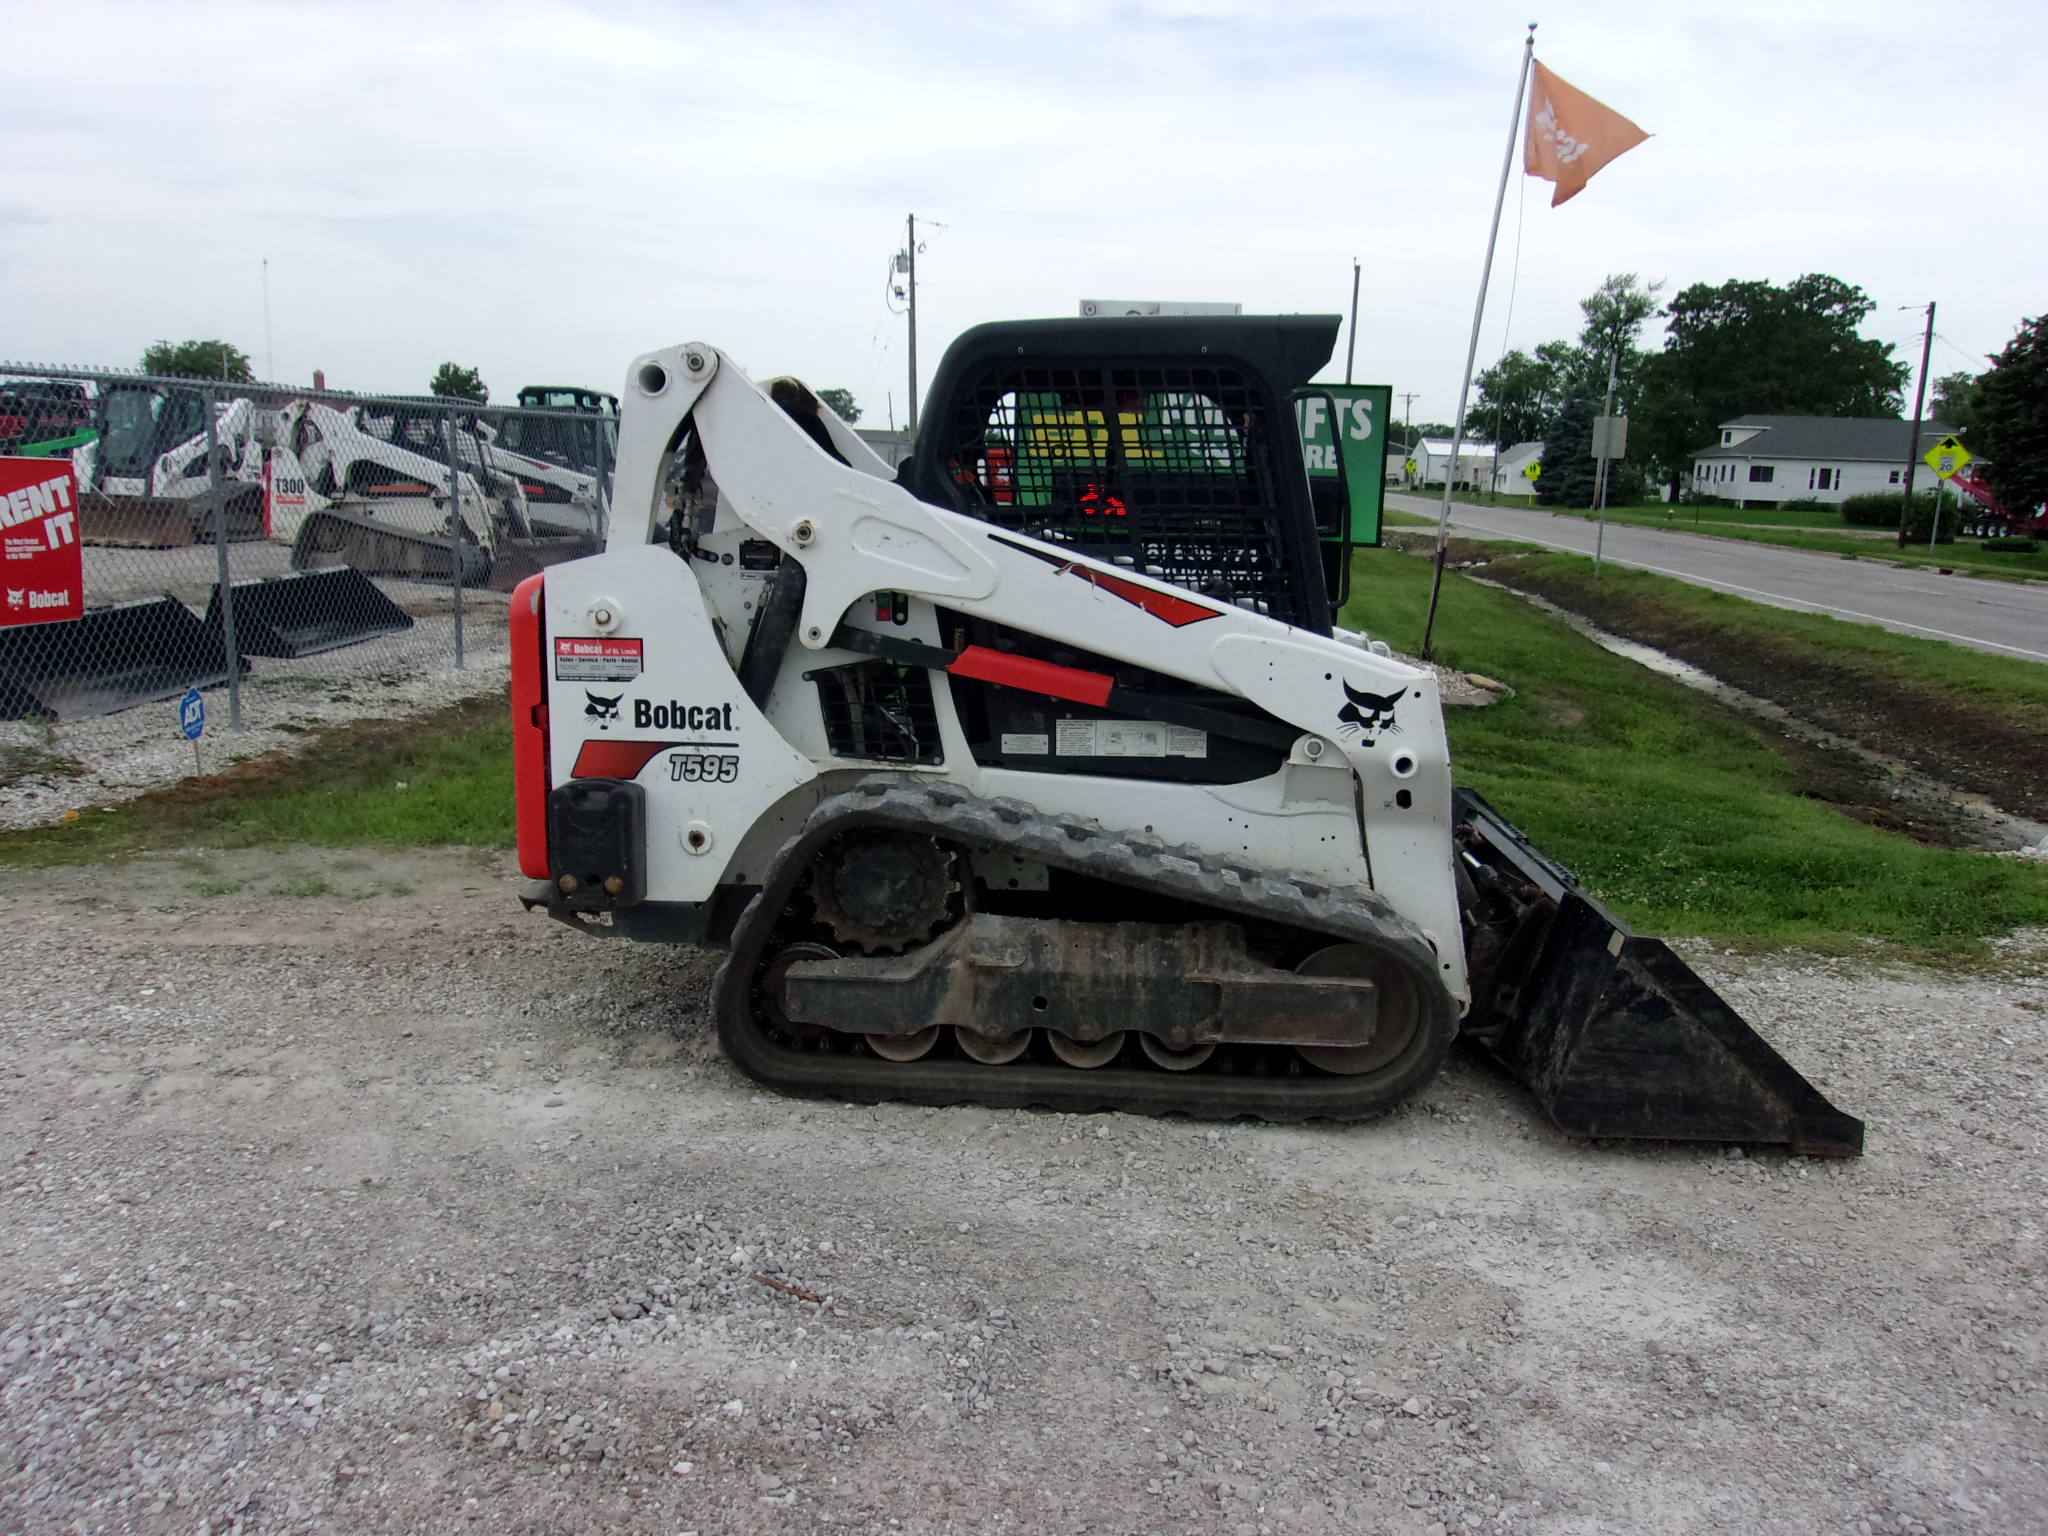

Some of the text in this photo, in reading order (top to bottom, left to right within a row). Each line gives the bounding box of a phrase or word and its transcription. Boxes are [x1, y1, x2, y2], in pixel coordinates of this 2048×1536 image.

[1297, 396, 1373, 440] FTS
[274, 478, 305, 495] T300
[0, 474, 71, 531] RENT
[43, 511, 75, 550] IT
[28, 589, 70, 609] Bobcat
[573, 643, 603, 654] Bobcat
[184, 699, 201, 727] ADT
[634, 698, 732, 731] Bobcat
[669, 753, 740, 784] T595
